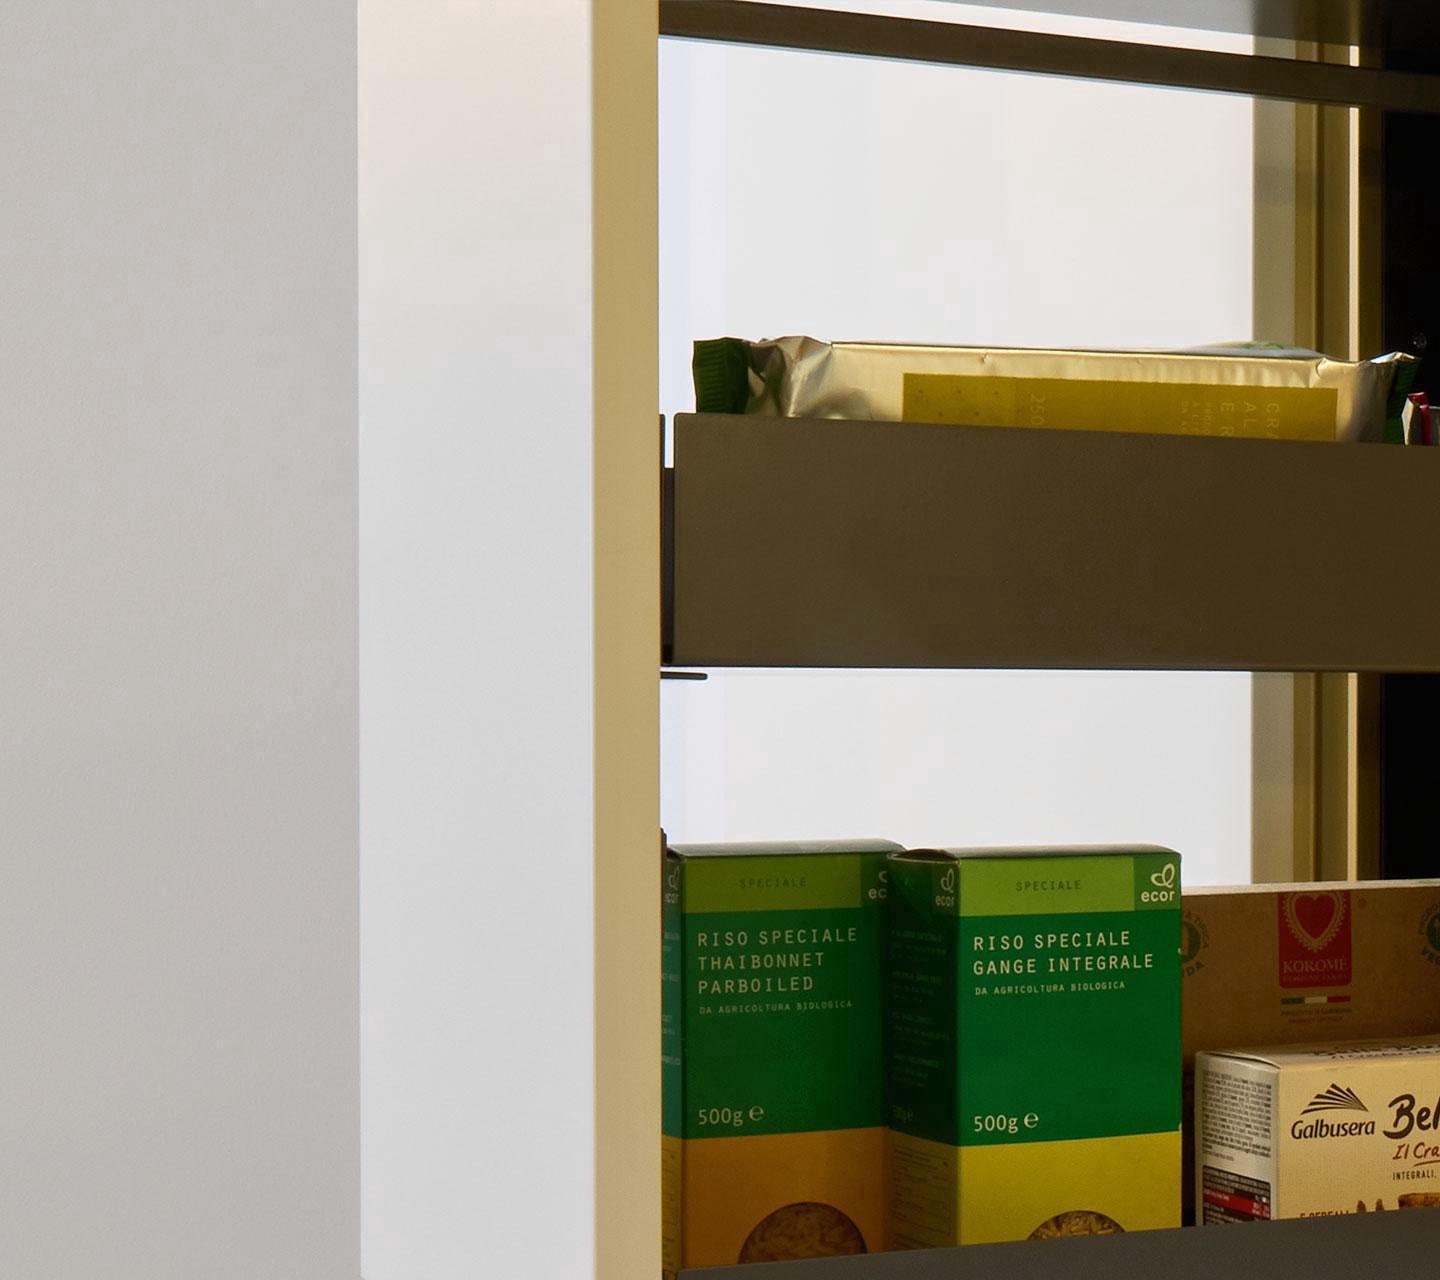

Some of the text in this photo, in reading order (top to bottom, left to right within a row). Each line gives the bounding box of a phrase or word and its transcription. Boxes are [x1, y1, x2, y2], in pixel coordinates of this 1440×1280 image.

[738, 877, 808, 890] SPECIALE
[868, 885, 888, 900] ec
[1015, 879, 1082, 892] SPECIALE
[1141, 888, 1175, 903] ecor
[698, 931, 749, 948] RISO
[758, 928, 858, 946] SPECIALE
[973, 931, 1131, 951] RISO SPECIALE
[698, 952, 825, 971] THAIBONNET
[973, 953, 1154, 976] GANGE INTEGRALE
[698, 976, 814, 995] PARBOILED
[975, 980, 1126, 996] DA AGRICOLTURA BIOLOGICA
[699, 1000, 853, 1015] DA AGRICOLTURA BIOLOGICA
[698, 1107, 744, 1127] 500g
[973, 1114, 1019, 1133] 500g
[1291, 1118, 1376, 1140] Galbusera
